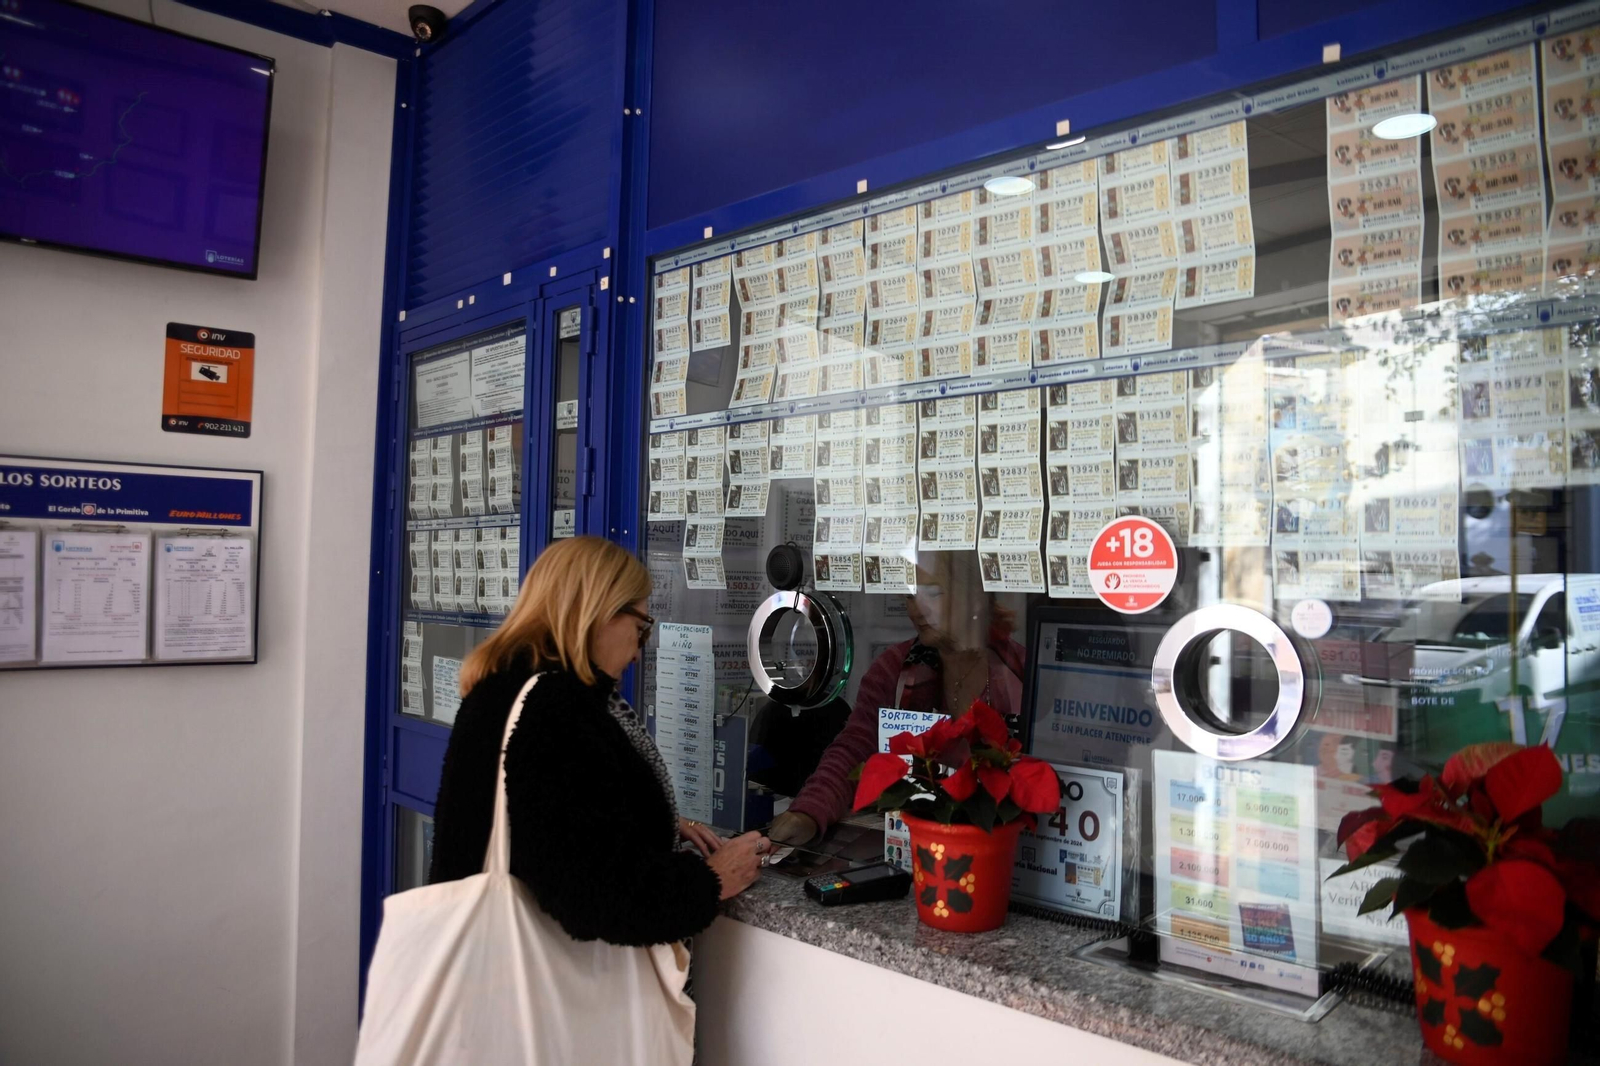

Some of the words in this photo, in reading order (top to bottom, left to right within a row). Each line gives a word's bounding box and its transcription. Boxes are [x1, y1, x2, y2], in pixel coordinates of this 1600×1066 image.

[1197, 163, 1231, 179] 22350
[1055, 196, 1084, 209] 39178
[994, 209, 1020, 222] 12557
[1200, 211, 1234, 225] 22350
[937, 224, 961, 236] 10707
[1056, 240, 1085, 254] 39178
[995, 252, 1021, 264] 12557
[936, 264, 961, 276] 10707
[1204, 260, 1238, 274] 22350
[1059, 285, 1088, 296] 39178
[999, 294, 1025, 306] 12557
[939, 305, 964, 317] 10707
[1055, 325, 1084, 337] 39178
[992, 332, 1019, 344] 12557
[180, 344, 240, 360] SEGURIDAD
[935, 345, 960, 356] 10707
[1139, 410, 1171, 421] 81419
[1000, 422, 1027, 433] 92837
[1070, 418, 1100, 430] 13928
[1070, 464, 1100, 475] 13928
[1141, 457, 1174, 470] 81419
[1000, 466, 1028, 477] 92837
[0, 472, 33, 486] LOS
[40, 474, 122, 491] SORTEOS
[116, 508, 149, 516] Primitiva
[1002, 510, 1030, 520] 92837
[1072, 509, 1102, 520] 13928
[1142, 504, 1175, 517] 81419
[1106, 526, 1155, 558] +18
[1000, 552, 1028, 562] 92837
[662, 624, 710, 634] PARTICIPACIONES
[672, 639, 693, 649] NIÑO
[1077, 648, 1089, 659] NO
[1090, 649, 1136, 662] PREMIADO
[1411, 697, 1438, 706] BOTE
[1440, 697, 1455, 706] DE
[880, 709, 917, 721] SORTEO
[922, 712, 933, 721] DE
[1053, 698, 1152, 728] BIENVENIDO
[1051, 723, 1060, 732] ES
[1061, 724, 1074, 733] UN
[1075, 726, 1104, 739] PLACER
[1105, 730, 1151, 745] ATENDERLE
[1070, 839, 1083, 847] 2024
[1027, 861, 1058, 876] Nacional
[1185, 895, 1214, 909] 31.000
